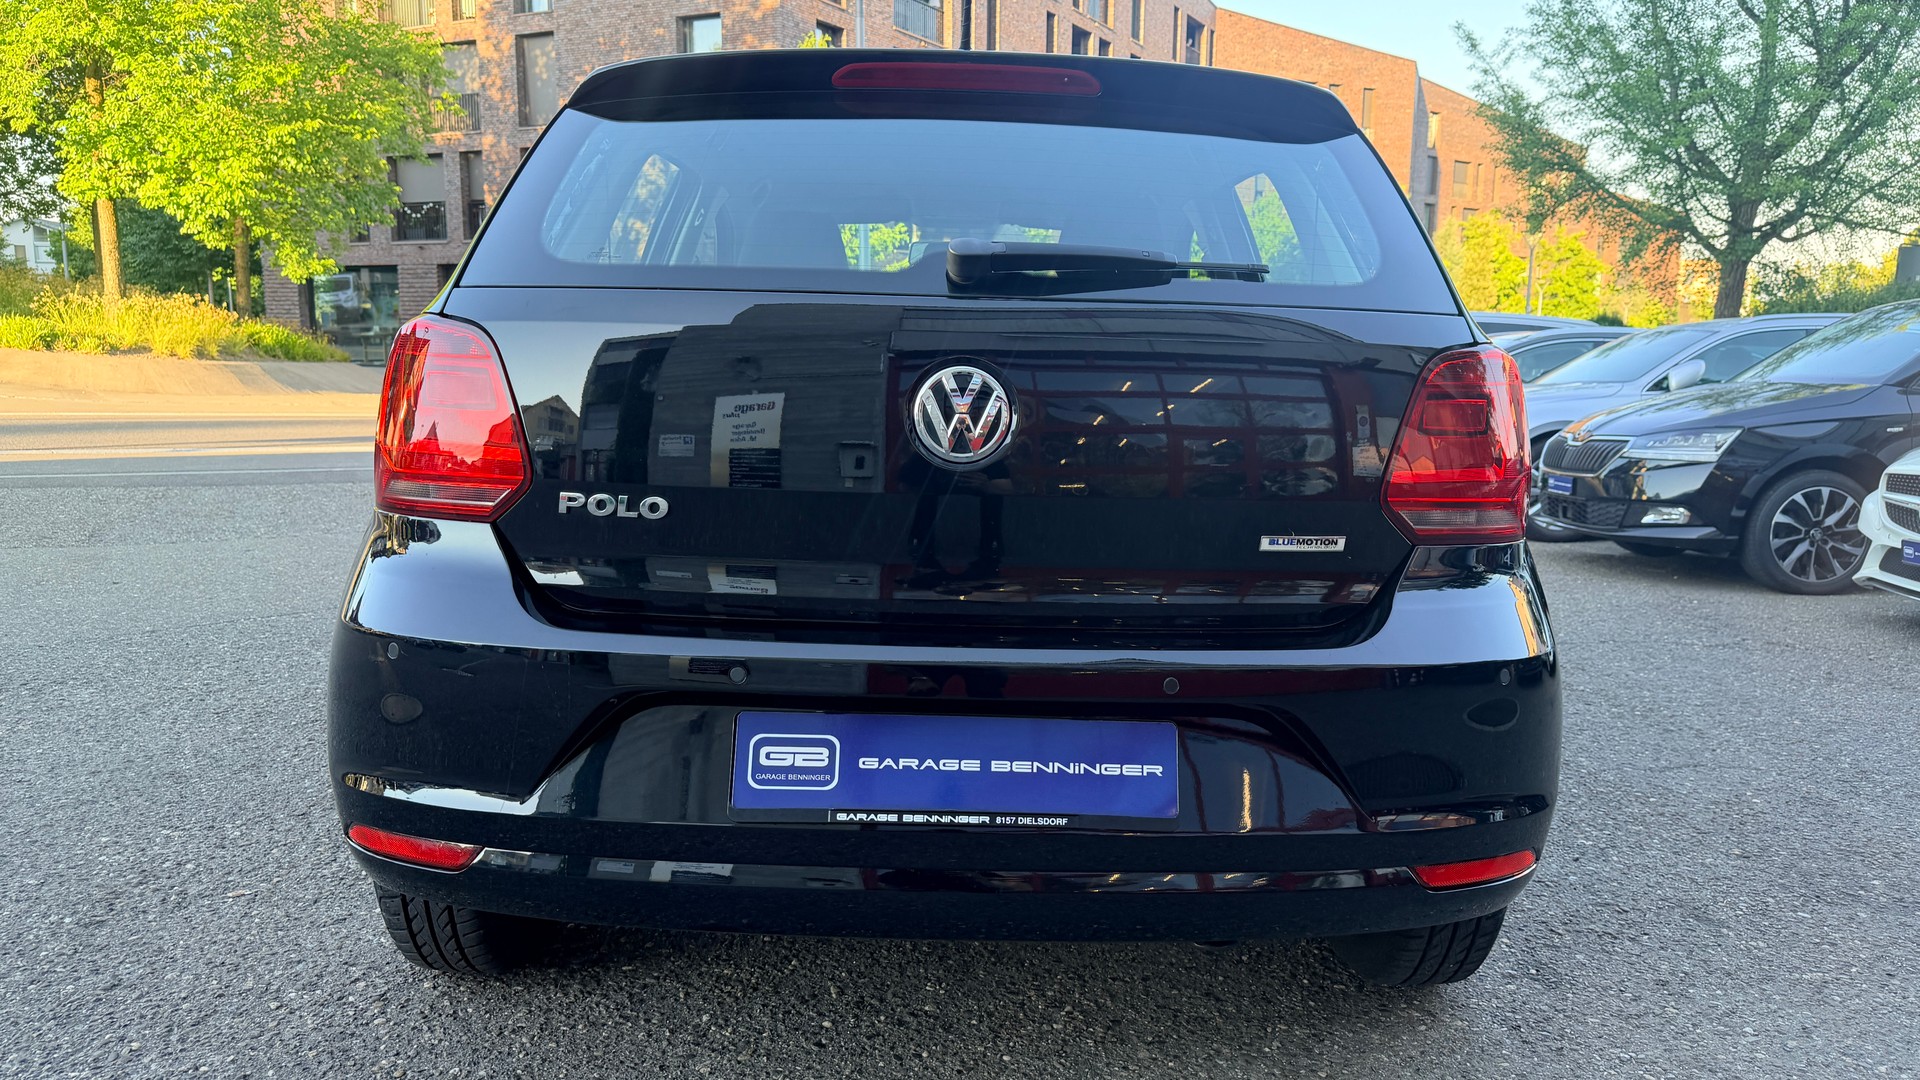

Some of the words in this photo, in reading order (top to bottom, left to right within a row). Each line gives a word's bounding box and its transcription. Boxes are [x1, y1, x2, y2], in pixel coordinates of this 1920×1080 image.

[558, 491, 669, 520] POLO
[1268, 538, 1339, 546] BLUEMOTION
[759, 746, 830, 767] GB
[858, 756, 981, 772] GARAGE
[755, 773, 787, 781] GARAGE
[787, 773, 831, 781] BENNINGER
[836, 813, 899, 822] GARAGE
[995, 816, 1016, 825] 8157
[1018, 817, 1068, 826] DIELSDORF
